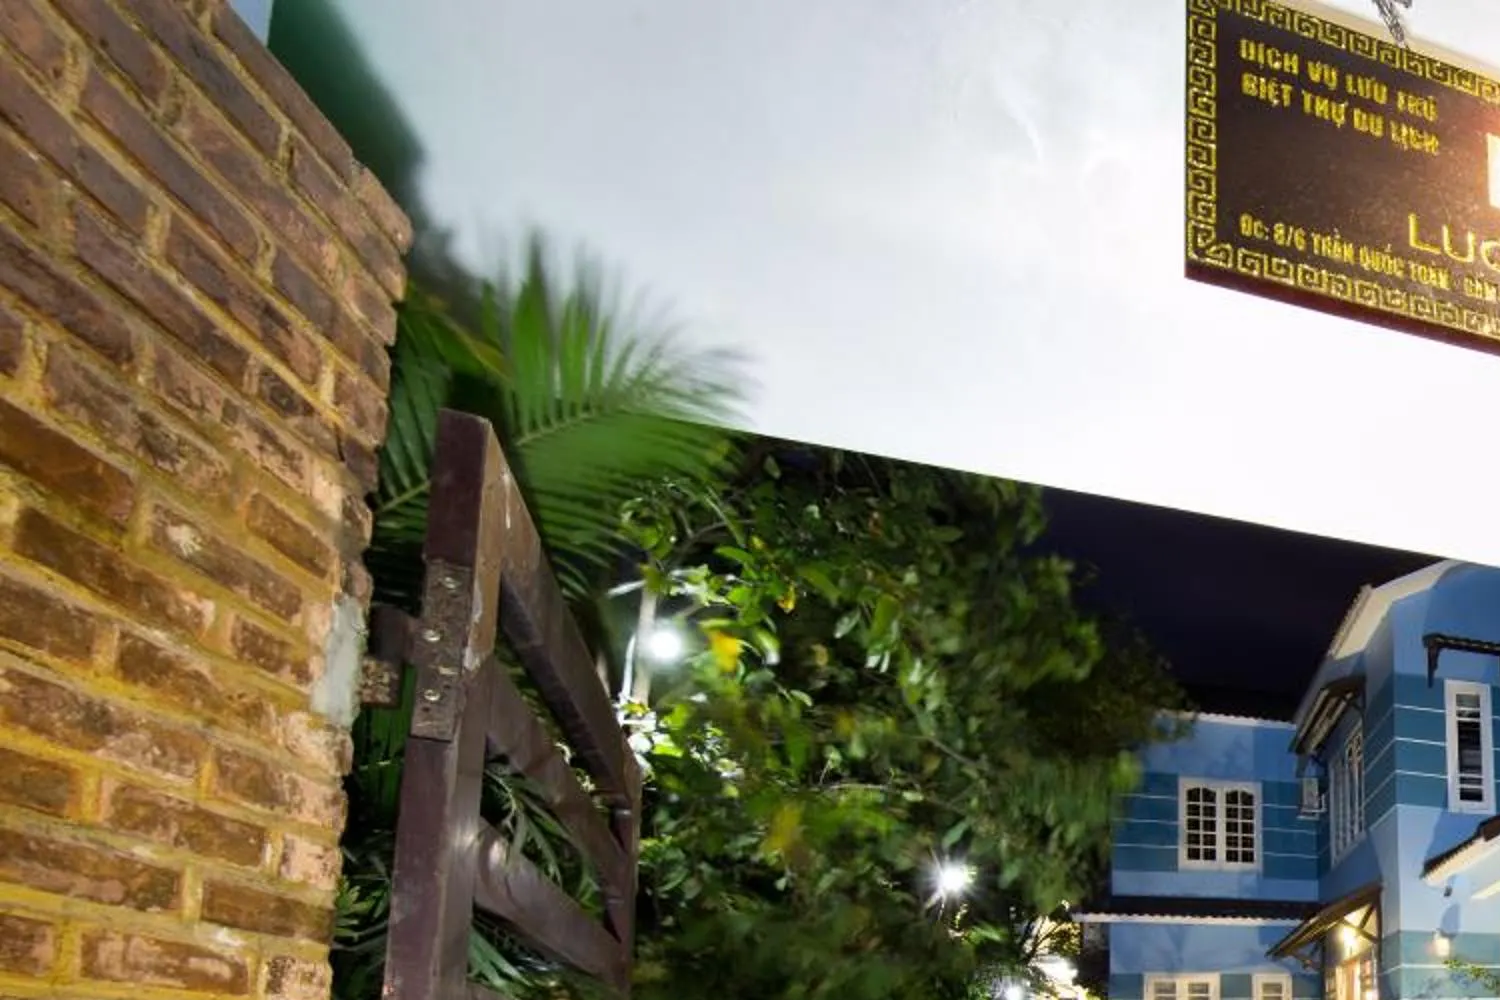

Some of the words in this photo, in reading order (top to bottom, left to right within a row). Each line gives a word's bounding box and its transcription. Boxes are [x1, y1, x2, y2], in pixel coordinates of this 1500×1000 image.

[1239, 38, 1299, 76] DỊCH
[1306, 60, 1339, 91] VỤ
[1241, 72, 1293, 107] BIỆT
[1353, 108, 1385, 138] DU
